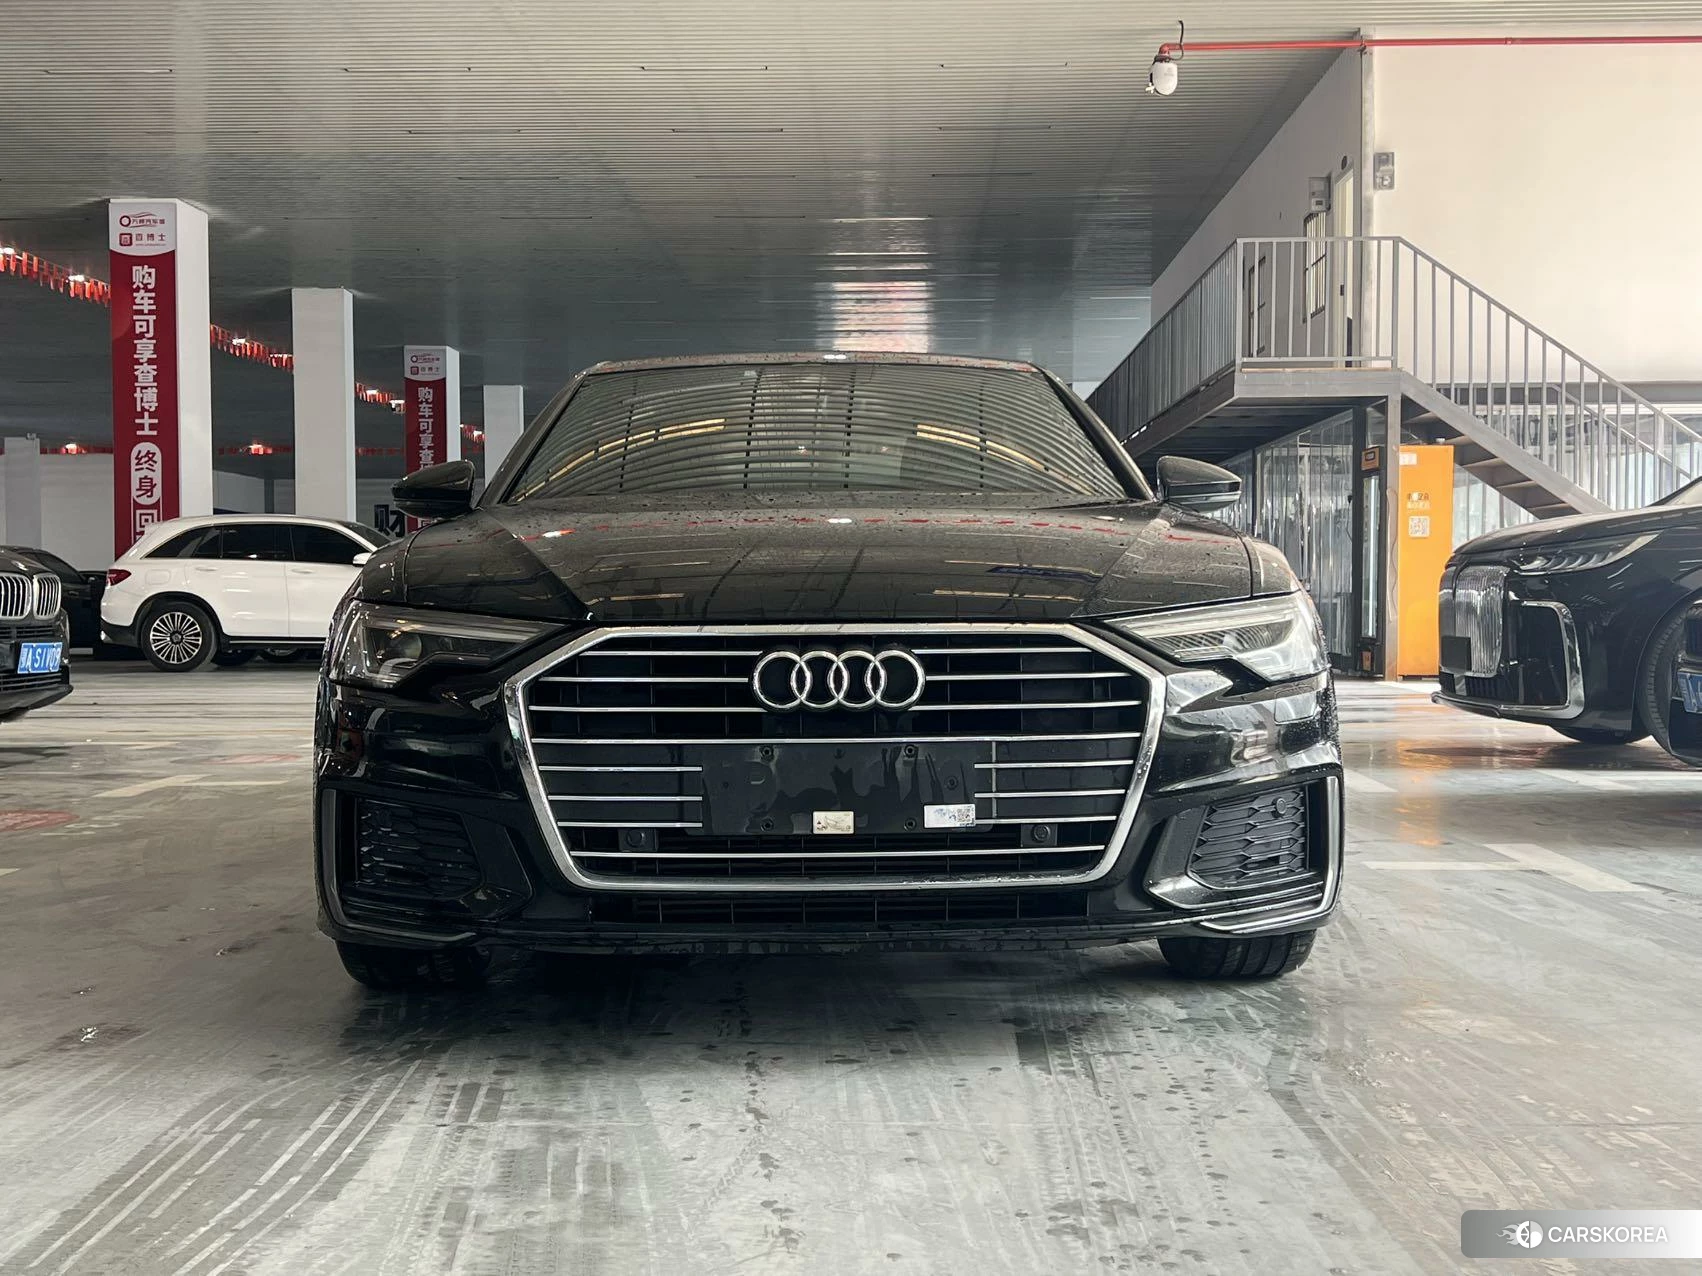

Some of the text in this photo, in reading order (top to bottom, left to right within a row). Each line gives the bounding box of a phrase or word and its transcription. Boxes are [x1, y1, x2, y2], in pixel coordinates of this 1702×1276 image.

[132, 265, 158, 435] 购车可享查博士
[134, 449, 158, 498] 终身
